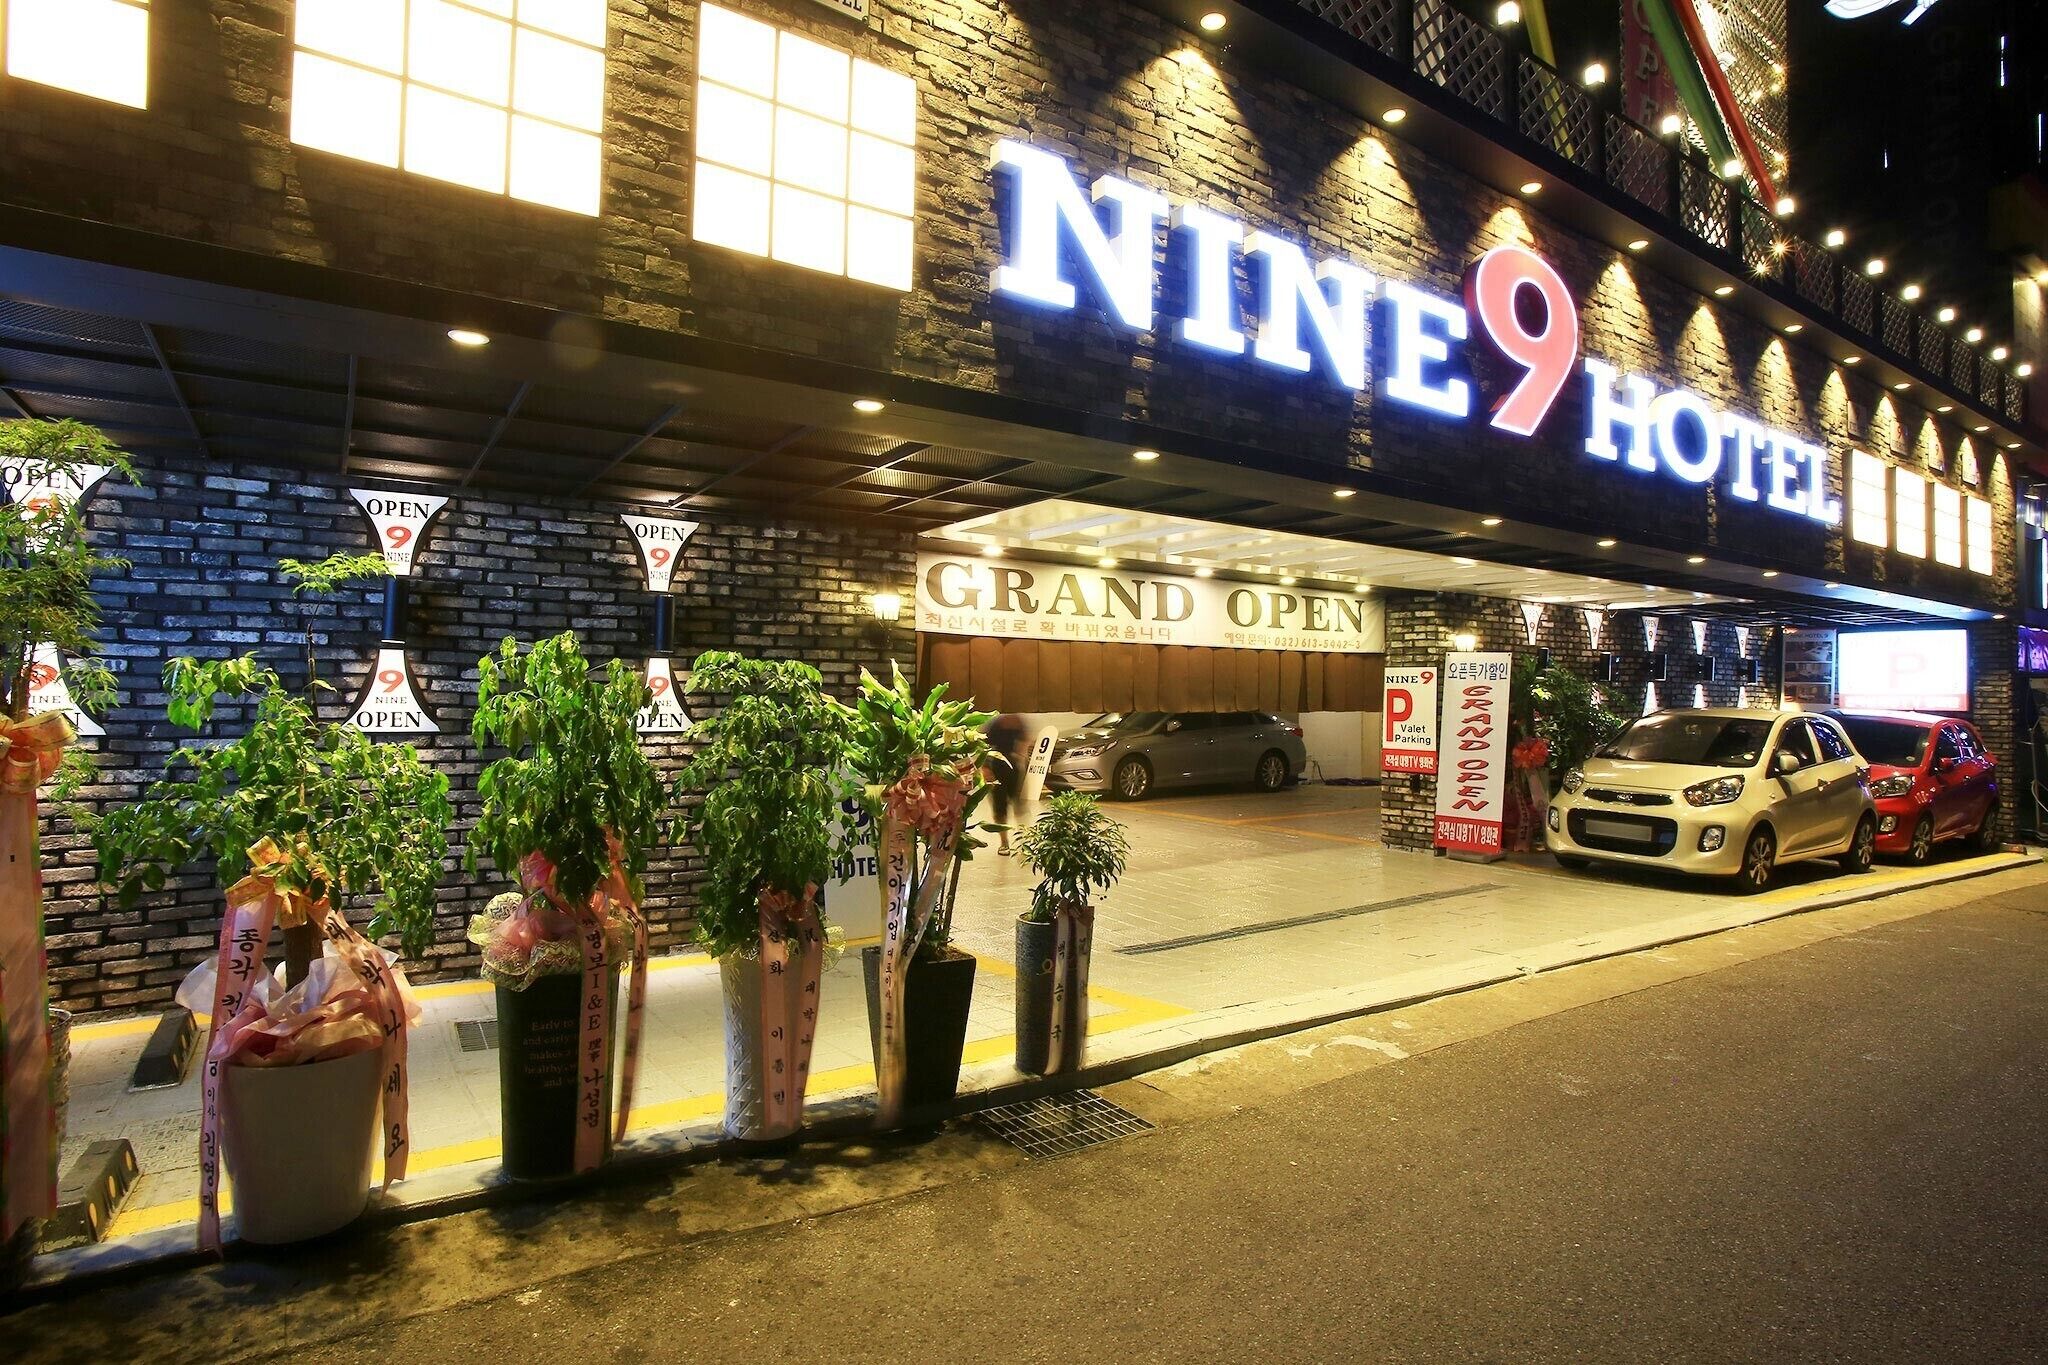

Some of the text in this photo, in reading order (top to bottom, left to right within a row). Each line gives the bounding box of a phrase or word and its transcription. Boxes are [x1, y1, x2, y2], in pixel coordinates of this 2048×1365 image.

[989, 138, 1841, 525] NINE 9 HOTEL
[2, 465, 86, 490] OPEN
[366, 498, 429, 519] OPEN
[386, 526, 412, 548] 9
[634, 523, 685, 541] OPEN
[386, 551, 410, 562] NINE
[650, 547, 670, 568] 9
[650, 570, 669, 580] NINE
[925, 561, 1365, 633] GRAND OPEN
[925, 612, 1027, 632] 최신시설로
[1040, 621, 1056, 636] 확
[378, 669, 405, 693] 9
[1385, 671, 1434, 685] NINE 9
[1447, 662, 1509, 682] 오픈특가할인
[649, 676, 670, 697] 9
[375, 696, 408, 704] NINE
[356, 711, 422, 728] OPEN
[1386, 688, 1413, 742] P
[1400, 724, 1426, 733] Valet
[1038, 737, 1050, 754] 9
[1394, 734, 1432, 745] Parking
[1451, 685, 1494, 812] GRAND OPEN
